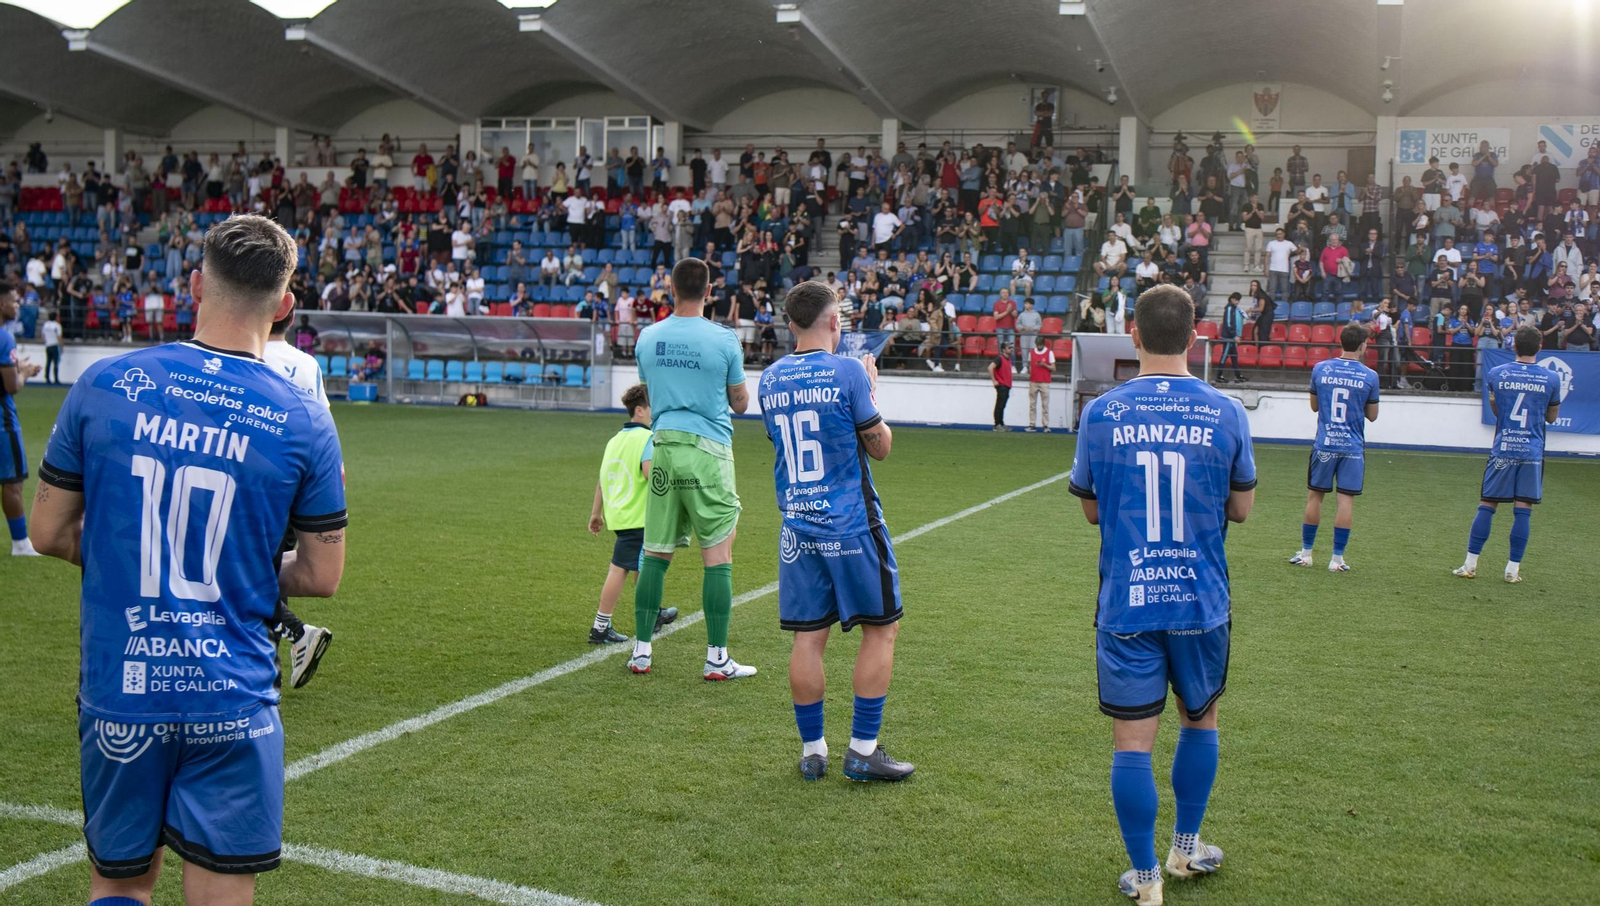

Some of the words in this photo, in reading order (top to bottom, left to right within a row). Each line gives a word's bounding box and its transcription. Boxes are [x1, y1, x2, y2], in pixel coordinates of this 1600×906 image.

[1431, 132, 1478, 144] XUNTA
[1430, 147, 1447, 158] DE
[1450, 146, 1507, 158] GALIA
[676, 350, 702, 358] GALICIA
[778, 372, 812, 382] recoletas
[814, 368, 836, 378] salud
[780, 366, 812, 374] HOSPITALES
[169, 371, 246, 395] HOSPITALES
[164, 385, 244, 410] recoletas
[246, 403, 289, 424] salud
[762, 392, 790, 411] AVID
[793, 386, 840, 405] MUÑOZ
[1331, 387, 1350, 424] 6
[1136, 402, 1190, 412] recoletas
[1193, 404, 1221, 416] salud
[1510, 392, 1528, 428] 4
[228, 413, 284, 436] OURENSE
[1182, 414, 1220, 424] OURENSE
[133, 412, 250, 463] MARTÍN
[1112, 424, 1214, 448] ARANZABE
[774, 410, 825, 484] 16
[1136, 450, 1186, 543] 11
[805, 514, 833, 525] GALICIA
[131, 454, 236, 603] 10
[840, 547, 863, 556] termal
[1144, 547, 1197, 559] Levagalia
[1147, 584, 1181, 594] XUNTA
[1148, 595, 1160, 604] DE
[1161, 593, 1198, 602] GALICIA
[150, 604, 227, 627] Levagalia
[1167, 628, 1203, 636] rovincia
[151, 665, 205, 678] XUNTA
[151, 680, 171, 692] DE
[174, 679, 238, 692] GALICIA
[186, 730, 245, 745] provincia
[248, 722, 274, 739] termal
